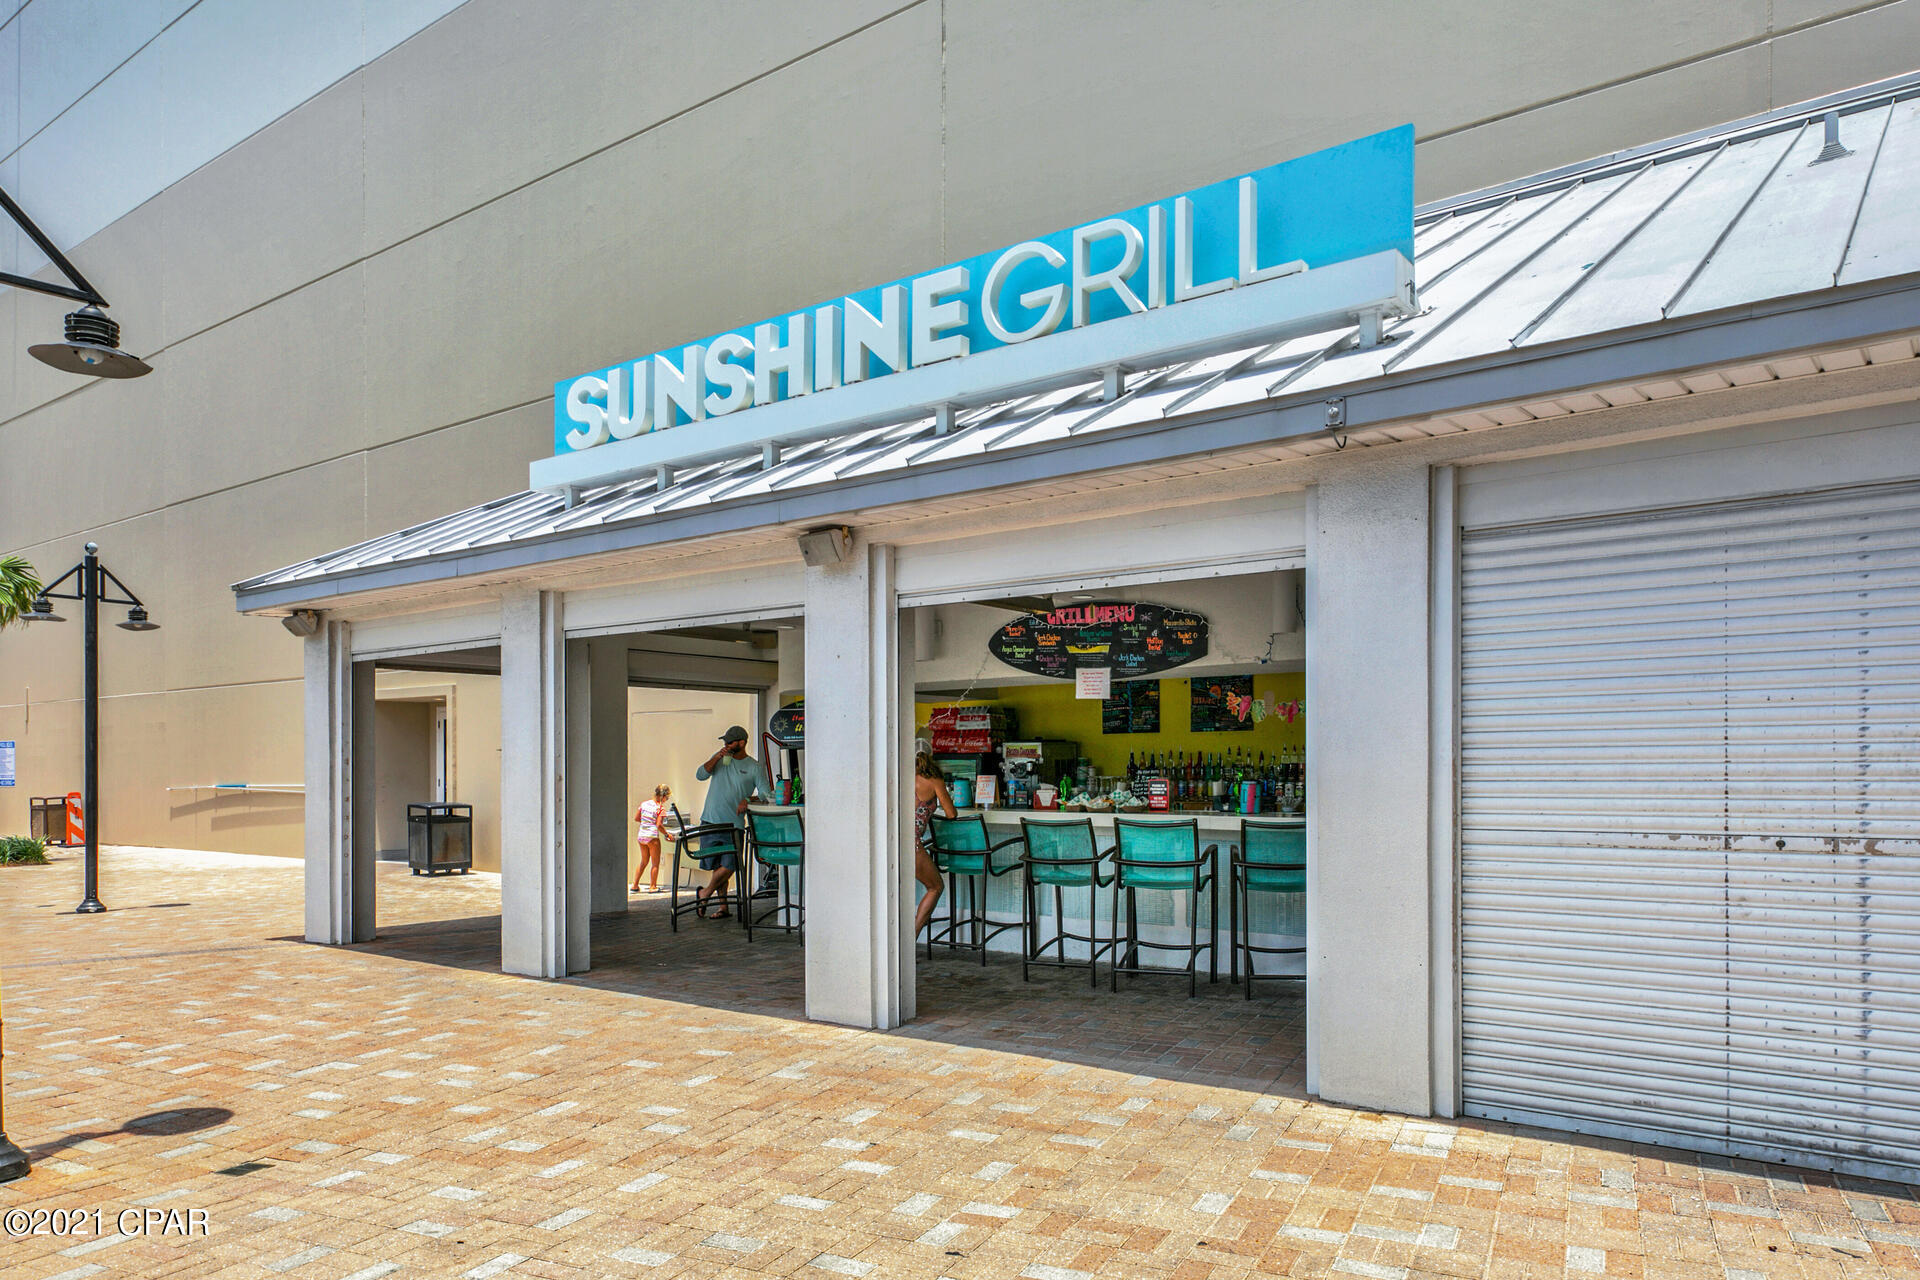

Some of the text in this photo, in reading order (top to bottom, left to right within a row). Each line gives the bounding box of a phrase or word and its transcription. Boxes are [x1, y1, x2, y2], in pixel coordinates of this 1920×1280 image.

[567, 176, 1309, 451] SUNSHINE GRILL
[1096, 605, 1136, 623] MENU
